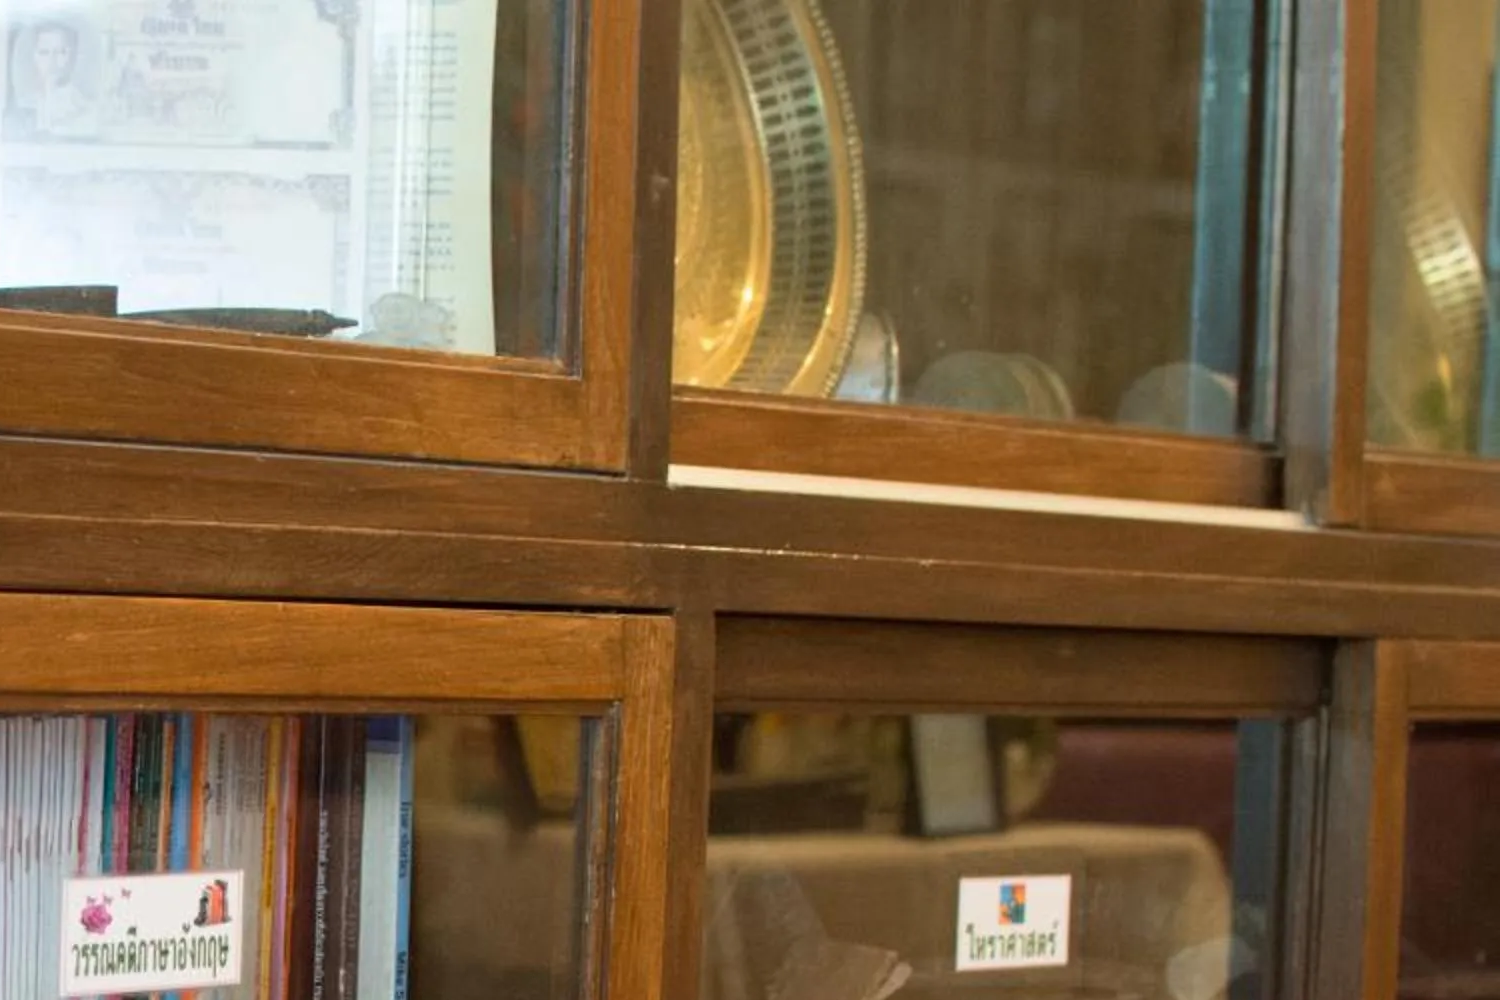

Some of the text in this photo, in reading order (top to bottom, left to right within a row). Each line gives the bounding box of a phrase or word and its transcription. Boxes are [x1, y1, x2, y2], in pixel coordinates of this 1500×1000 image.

[71, 921, 229, 978] วรรณคดีภาษาอังกฤษ
[964, 920, 1060, 961] โหราศาสตร์
[395, 951, 408, 987] Mike
